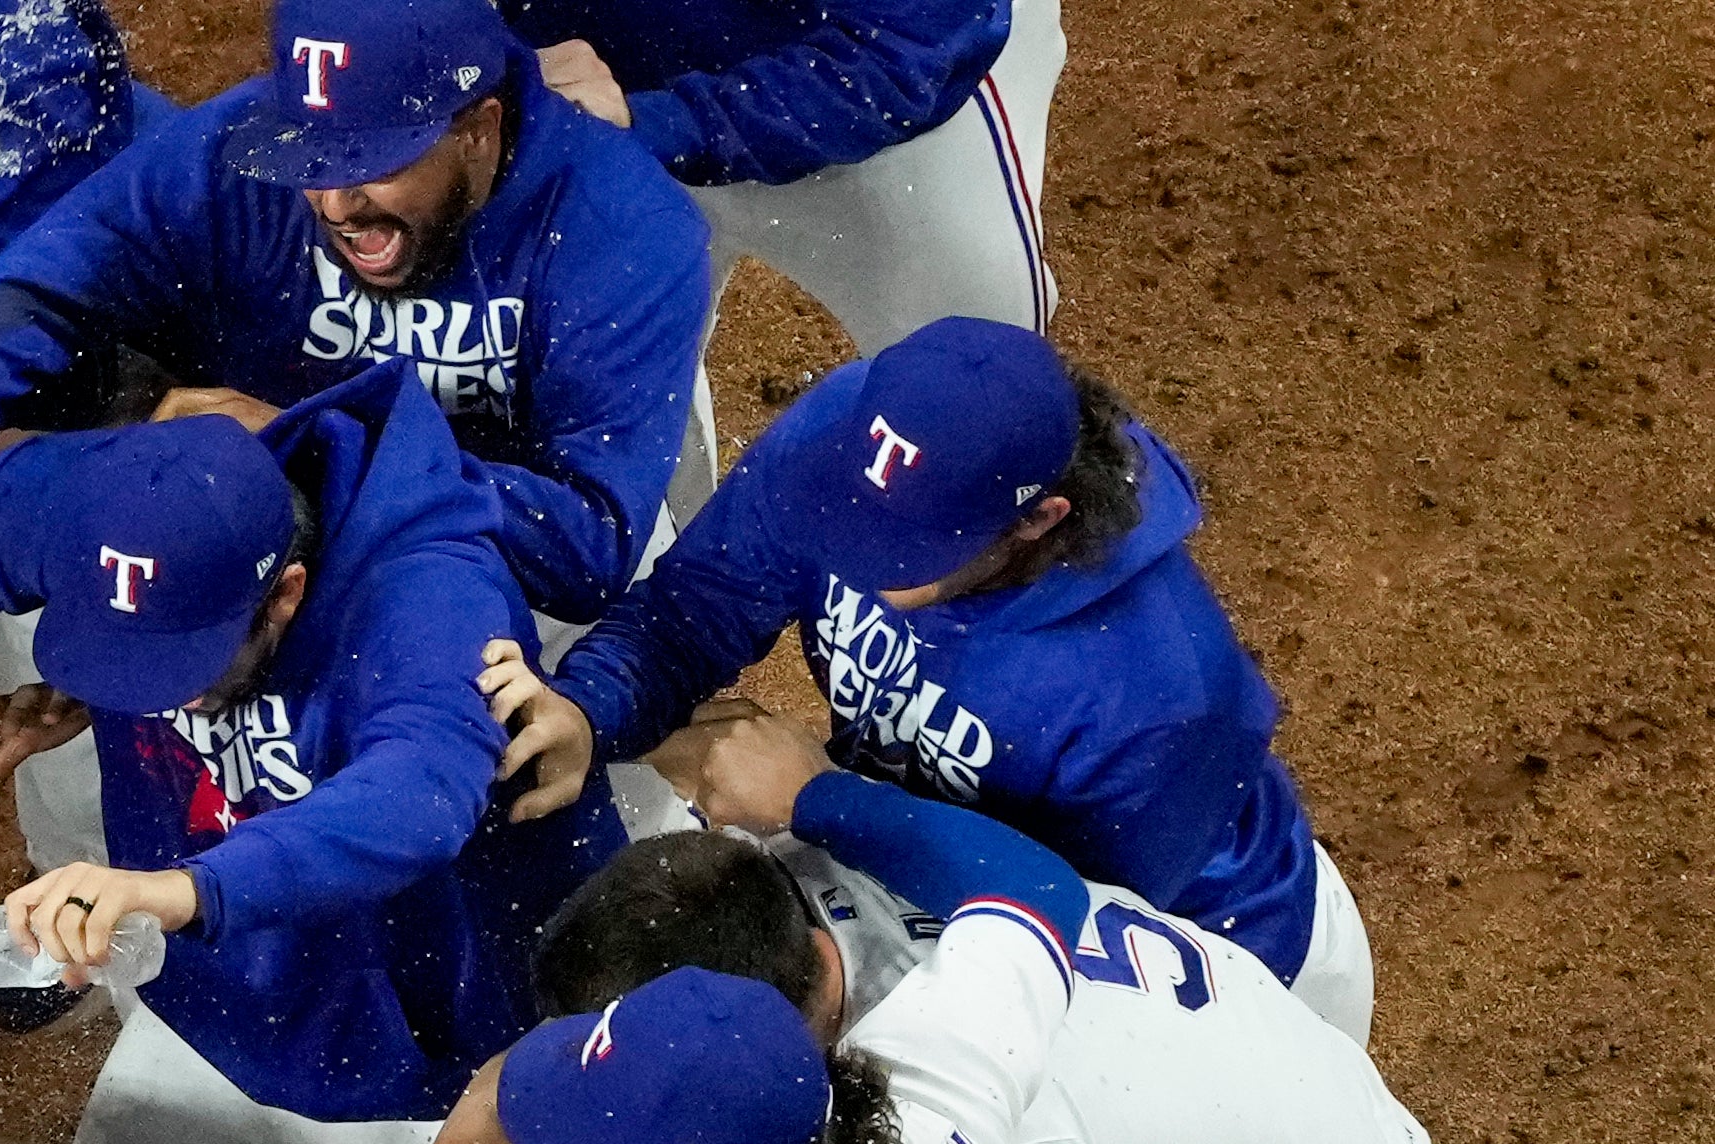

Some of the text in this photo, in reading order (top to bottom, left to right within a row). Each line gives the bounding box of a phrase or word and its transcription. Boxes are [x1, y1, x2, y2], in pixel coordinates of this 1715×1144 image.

[293, 37, 350, 110] T
[864, 414, 923, 492] T
[100, 545, 157, 613] T
[1073, 897, 1218, 1016] 5
